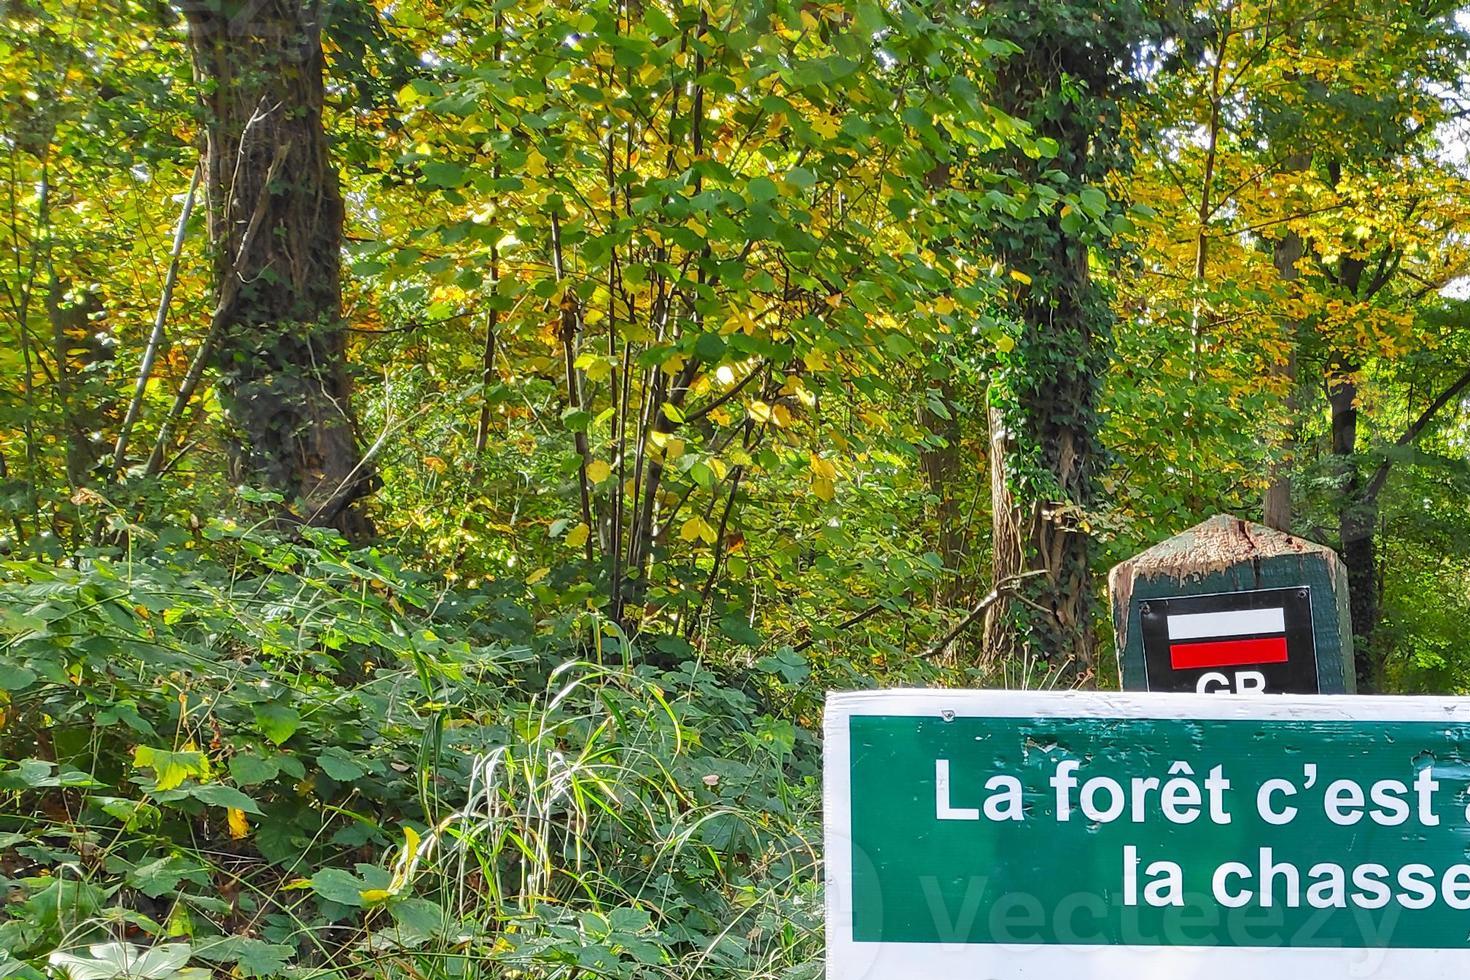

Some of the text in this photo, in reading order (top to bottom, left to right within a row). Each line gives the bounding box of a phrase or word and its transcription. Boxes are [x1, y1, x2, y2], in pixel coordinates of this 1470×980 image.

[934, 759, 1025, 821] La
[1049, 760, 1233, 825] forêt
[1256, 763, 1436, 826] c’est
[1123, 845, 1185, 907] la
